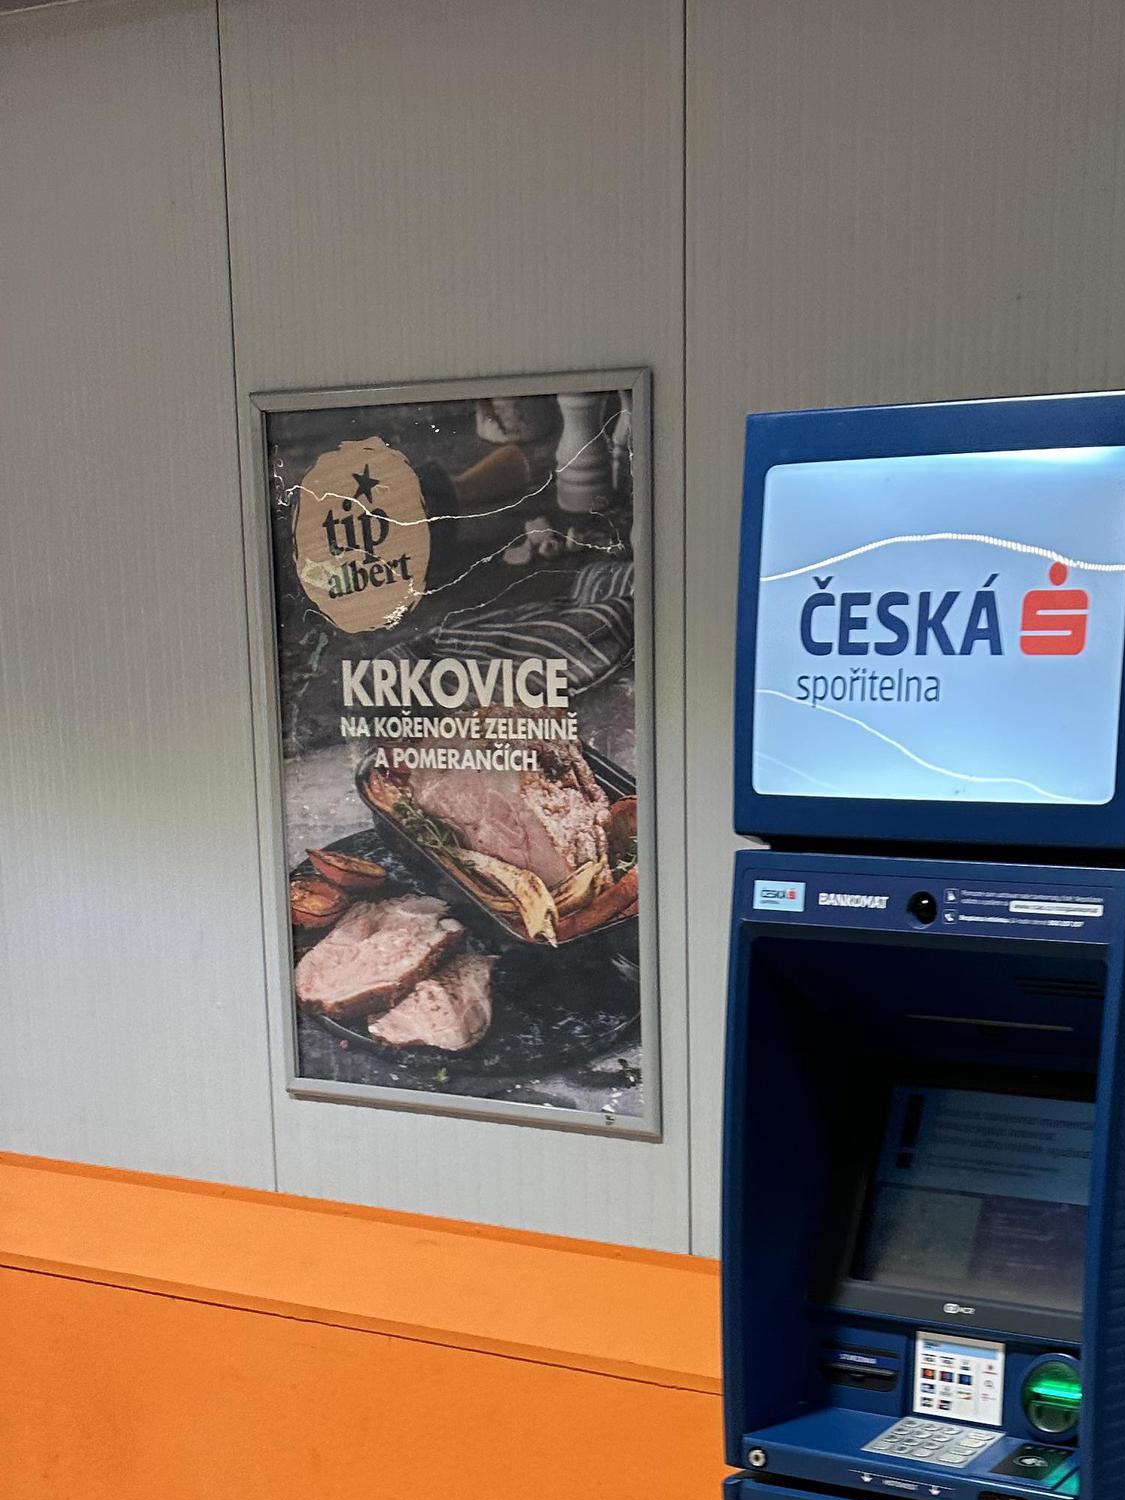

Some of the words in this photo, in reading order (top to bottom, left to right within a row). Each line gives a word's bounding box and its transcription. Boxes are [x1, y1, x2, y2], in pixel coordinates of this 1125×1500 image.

[322, 500, 389, 564] tip
[328, 553, 412, 598] albert
[799, 573, 1004, 657] ČESKÁ
[343, 658, 569, 708] KRKOVICE
[796, 666, 941, 709] spořitelna
[340, 715, 371, 739] NA
[374, 710, 481, 739] KOŘENOVÉ
[484, 712, 578, 740] ZELENINĚ
[374, 746, 391, 769] A
[394, 742, 538, 771] POMERANČÍCH
[818, 892, 889, 909] BANKOMAT
